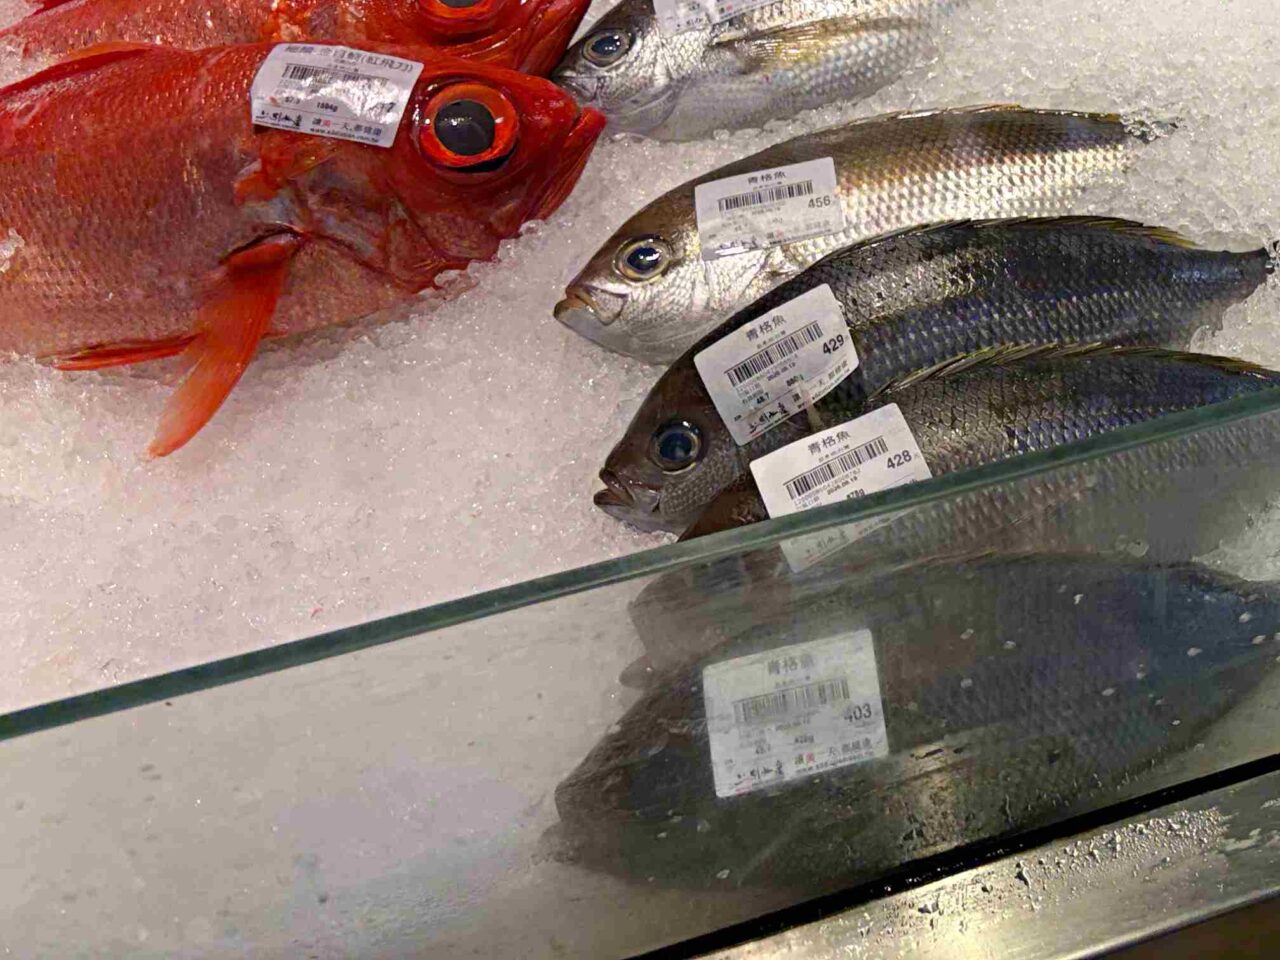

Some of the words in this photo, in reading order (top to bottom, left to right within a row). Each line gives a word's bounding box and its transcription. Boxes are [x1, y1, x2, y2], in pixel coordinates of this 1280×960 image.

[808, 195, 831, 209] 456
[822, 334, 845, 355] 429
[886, 449, 913, 470] 428
